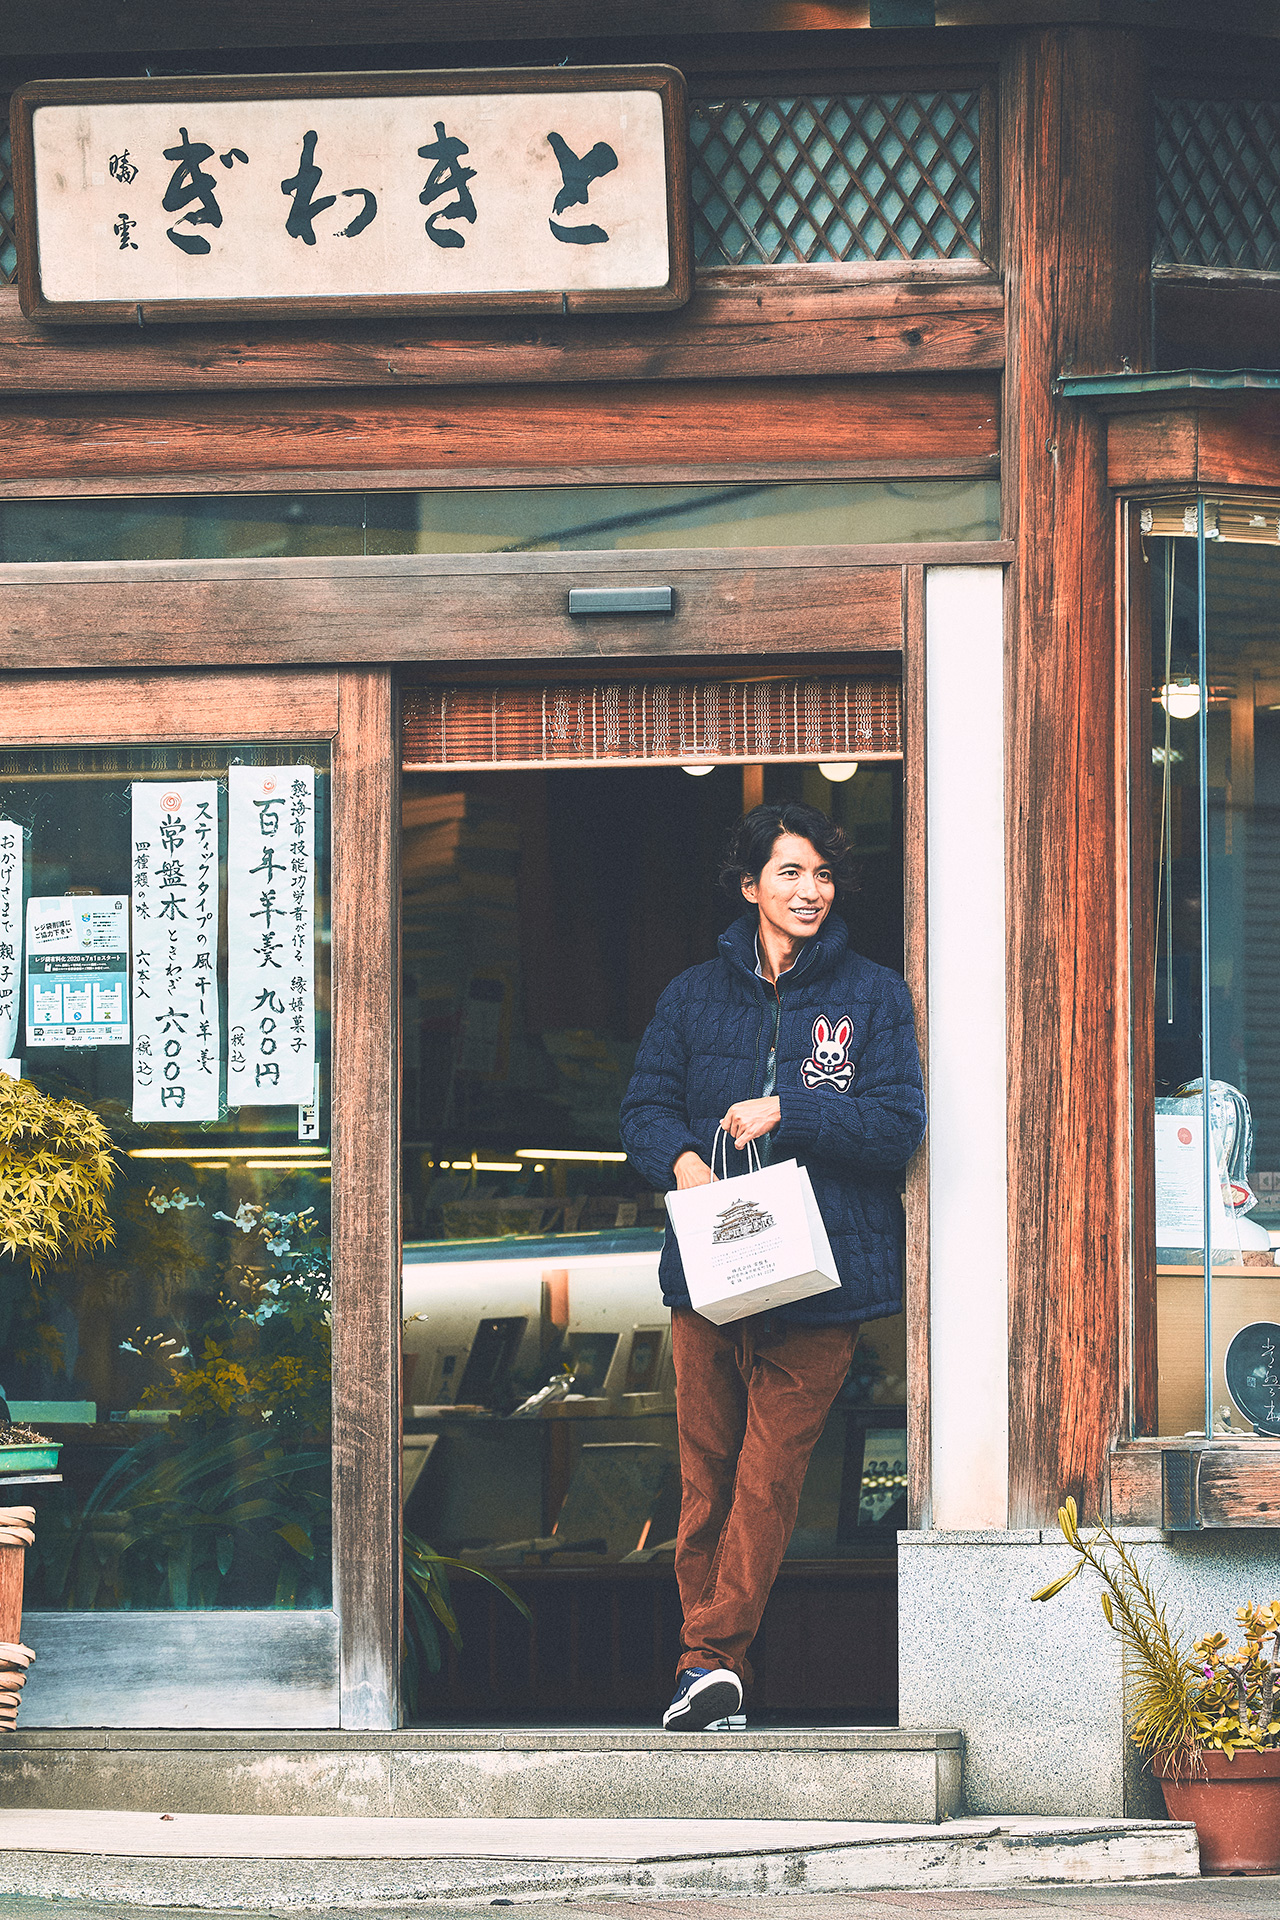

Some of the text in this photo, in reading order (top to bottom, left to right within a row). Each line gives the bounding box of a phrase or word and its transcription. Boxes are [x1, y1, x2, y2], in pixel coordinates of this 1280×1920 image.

[162, 121, 618, 255] ときわぎ
[155, 813, 189, 921] 常盤木
[249, 798, 287, 968] 百年羊羹
[165, 929, 183, 996] ときわぎ
